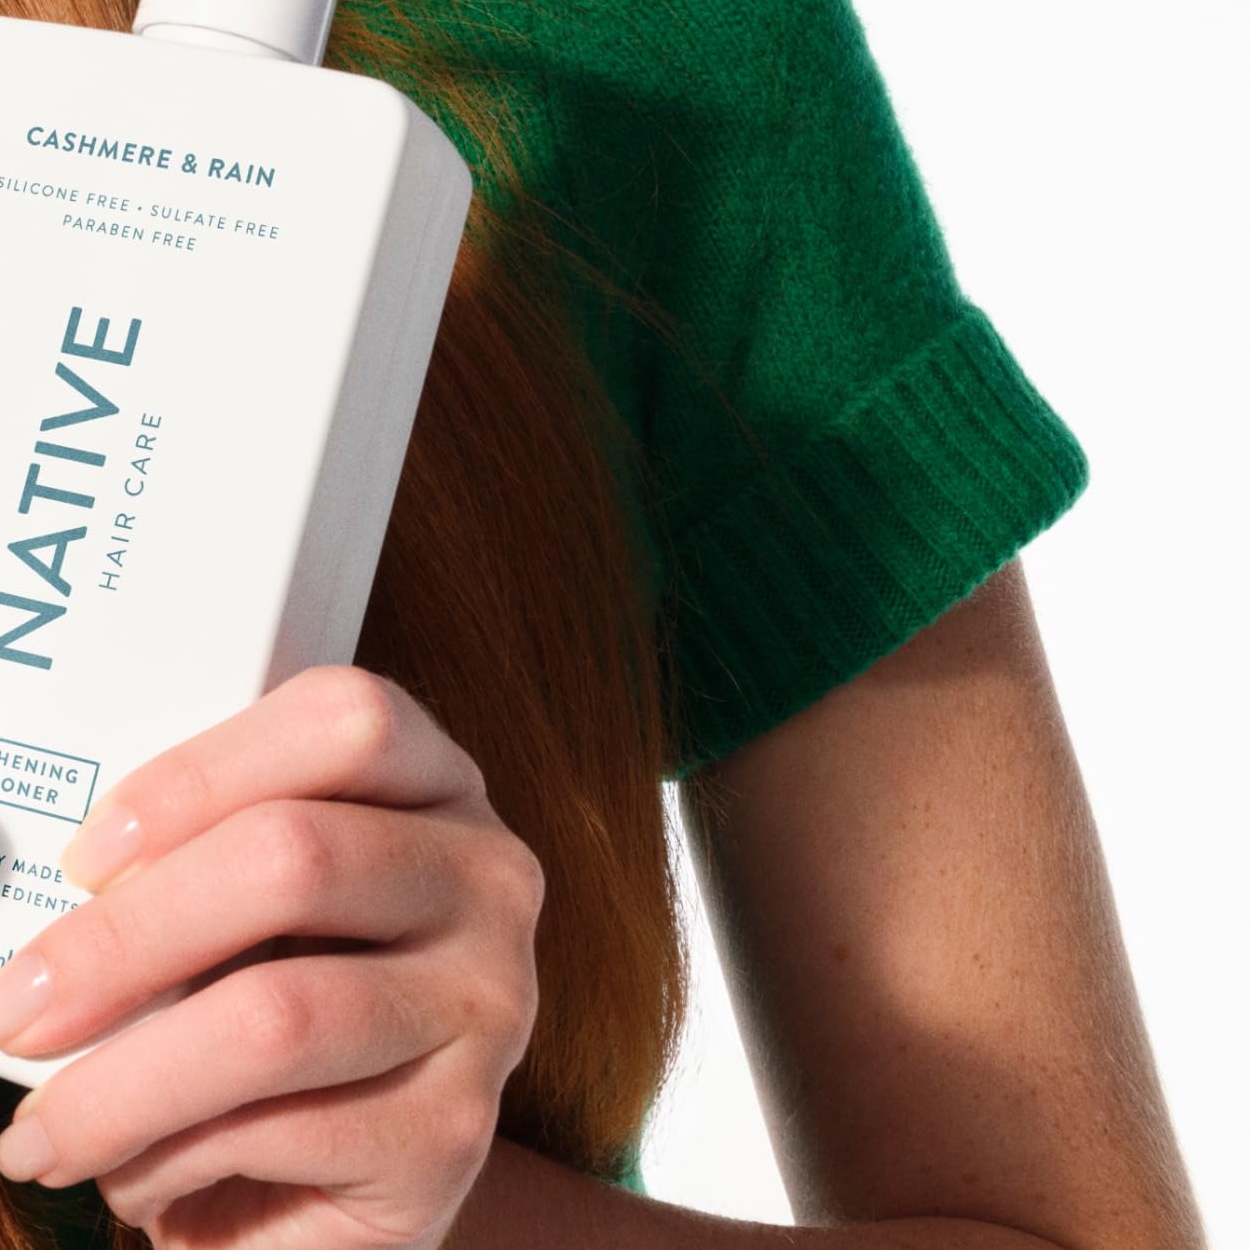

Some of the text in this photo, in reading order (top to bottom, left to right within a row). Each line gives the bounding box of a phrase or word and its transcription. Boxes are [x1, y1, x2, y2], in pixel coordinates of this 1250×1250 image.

[26, 126, 276, 188] CASHMERE & RAIN
[62, 214, 197, 251] PARABEN FREE
[86, 192, 130, 212] FREE
[150, 204, 227, 230] SULFATE
[234, 219, 279, 240] FREE
[98, 413, 162, 591] HAIR CARE
[11, 858, 63, 884] MADE
